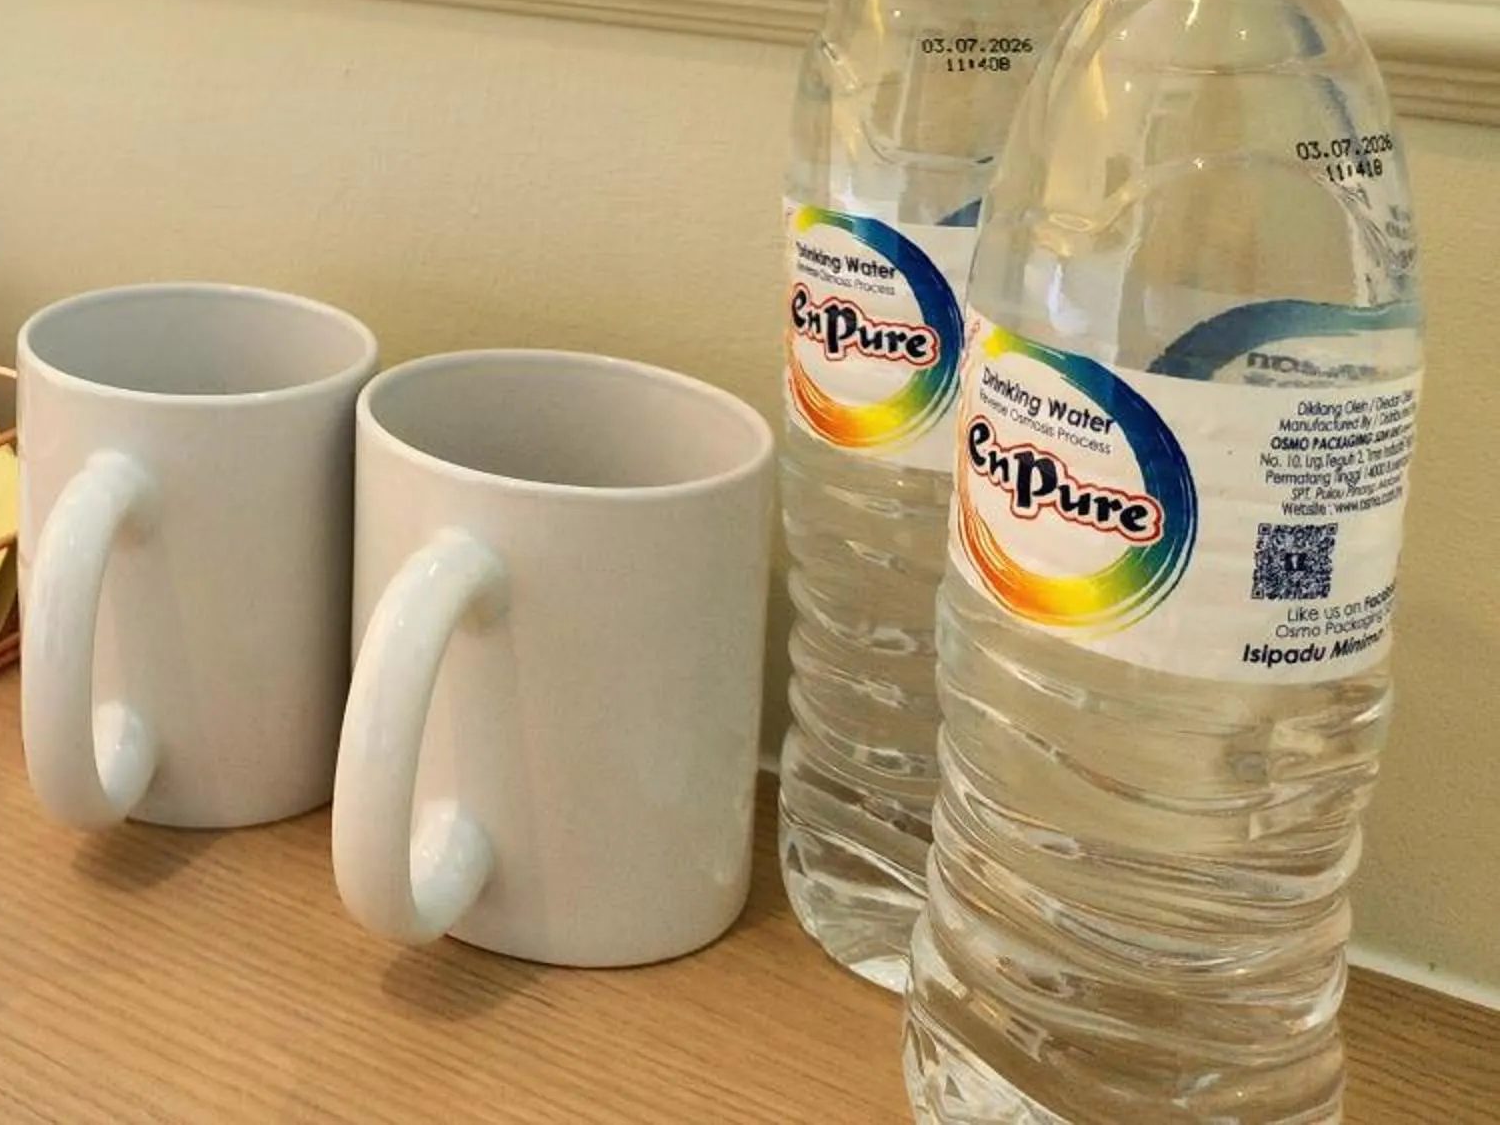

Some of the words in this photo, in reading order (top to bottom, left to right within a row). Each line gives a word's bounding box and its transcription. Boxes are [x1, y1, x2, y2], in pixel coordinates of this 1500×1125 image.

[921, 37, 1033, 54] 03.07.2026
[1295, 134, 1393, 161] 03.07.2026
[845, 255, 896, 280] Water
[854, 278, 896, 296] Process
[982, 366, 1042, 417] Drinking
[1048, 396, 1115, 435] Water
[1009, 405, 1055, 438] Osmosis
[1057, 429, 1112, 456] Process
[1279, 418, 1360, 433] Manufactured
[1270, 436, 1309, 451] OSMO
[1312, 432, 1374, 450] PACKAGING
[1260, 453, 1282, 469] No.
[1265, 470, 1332, 487] Permatang
[1282, 500, 1328, 516] Website
[1287, 606, 1319, 623] Like
[1323, 606, 1341, 620] us
[1343, 601, 1362, 615] on
[1275, 624, 1321, 639] Osmo
[1243, 642, 1327, 669] Isipadu
